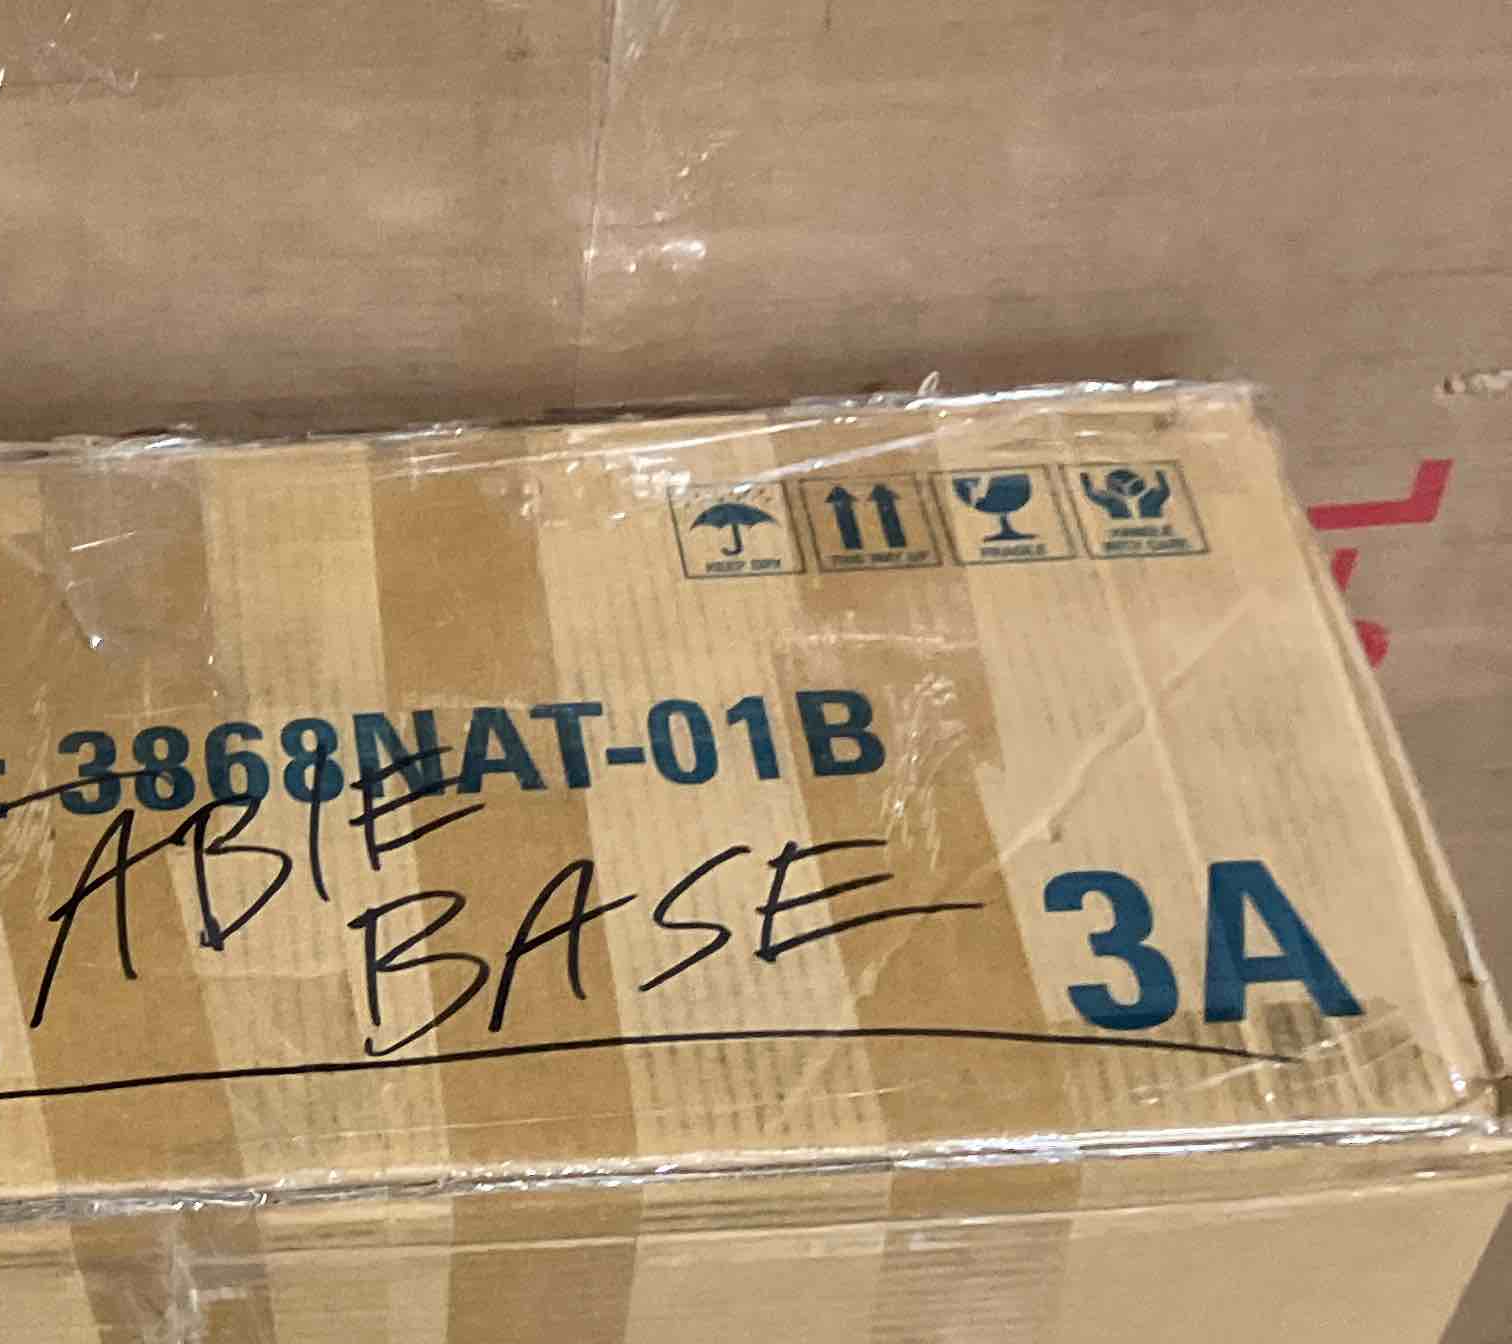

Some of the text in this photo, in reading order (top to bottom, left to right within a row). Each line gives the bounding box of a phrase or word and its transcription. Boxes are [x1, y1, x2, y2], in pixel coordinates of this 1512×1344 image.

[57, 687, 887, 816] 3868NAT-01B
[349, 840, 986, 1058] BASE
[1043, 859, 1365, 1032] 3A
